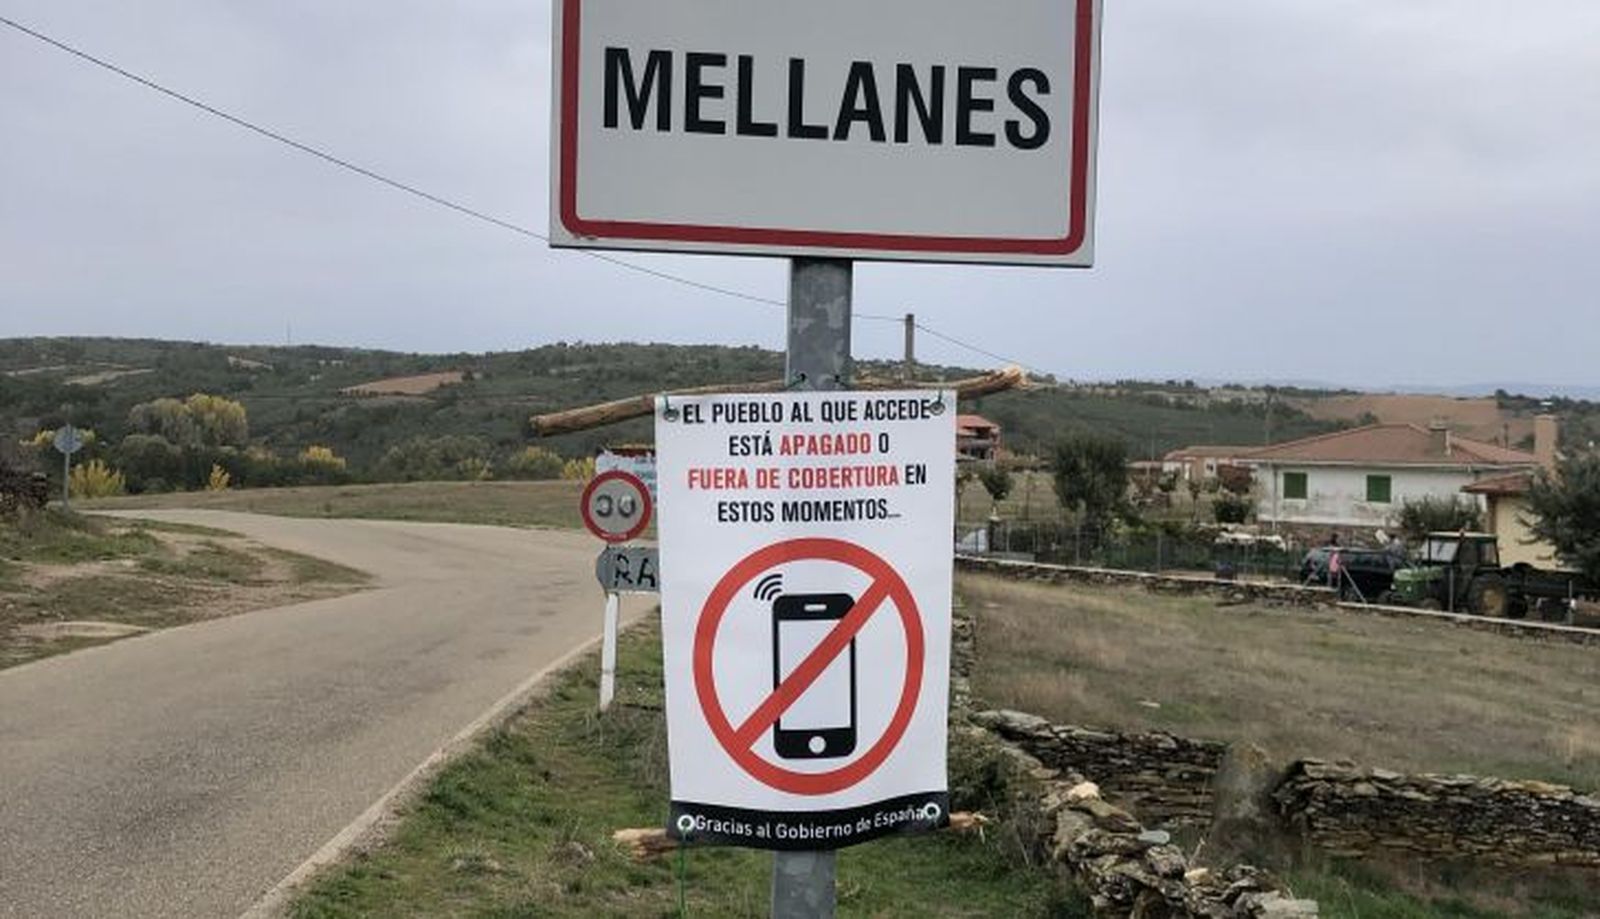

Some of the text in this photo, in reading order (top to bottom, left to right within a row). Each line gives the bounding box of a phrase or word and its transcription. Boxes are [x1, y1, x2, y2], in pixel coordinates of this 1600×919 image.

[603, 46, 1051, 150] MELLANES
[682, 399, 930, 424] EL PUEBLO AL QUE ACCEDE
[729, 430, 889, 456] ESTÁ APAGADO O
[688, 464, 927, 490] FUERA DE COBERTURA EN
[717, 501, 774, 523] ESTOS
[695, 805, 925, 839] Gracias al Gobierno de España
